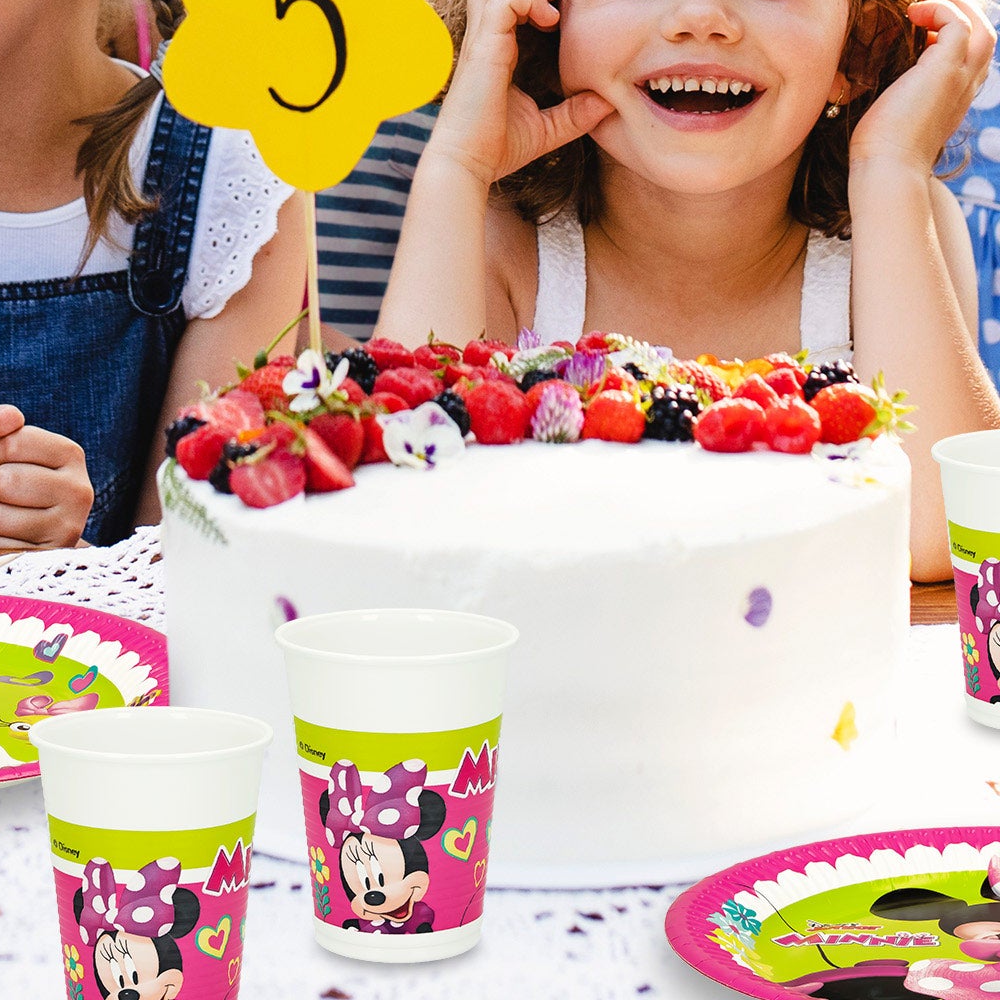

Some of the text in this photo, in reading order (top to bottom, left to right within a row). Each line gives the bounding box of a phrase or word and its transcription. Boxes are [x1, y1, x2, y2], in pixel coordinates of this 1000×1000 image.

[304, 743, 326, 760] Disney
[58, 842, 80, 858] Disney
[771, 932, 941, 947] MINNIE
